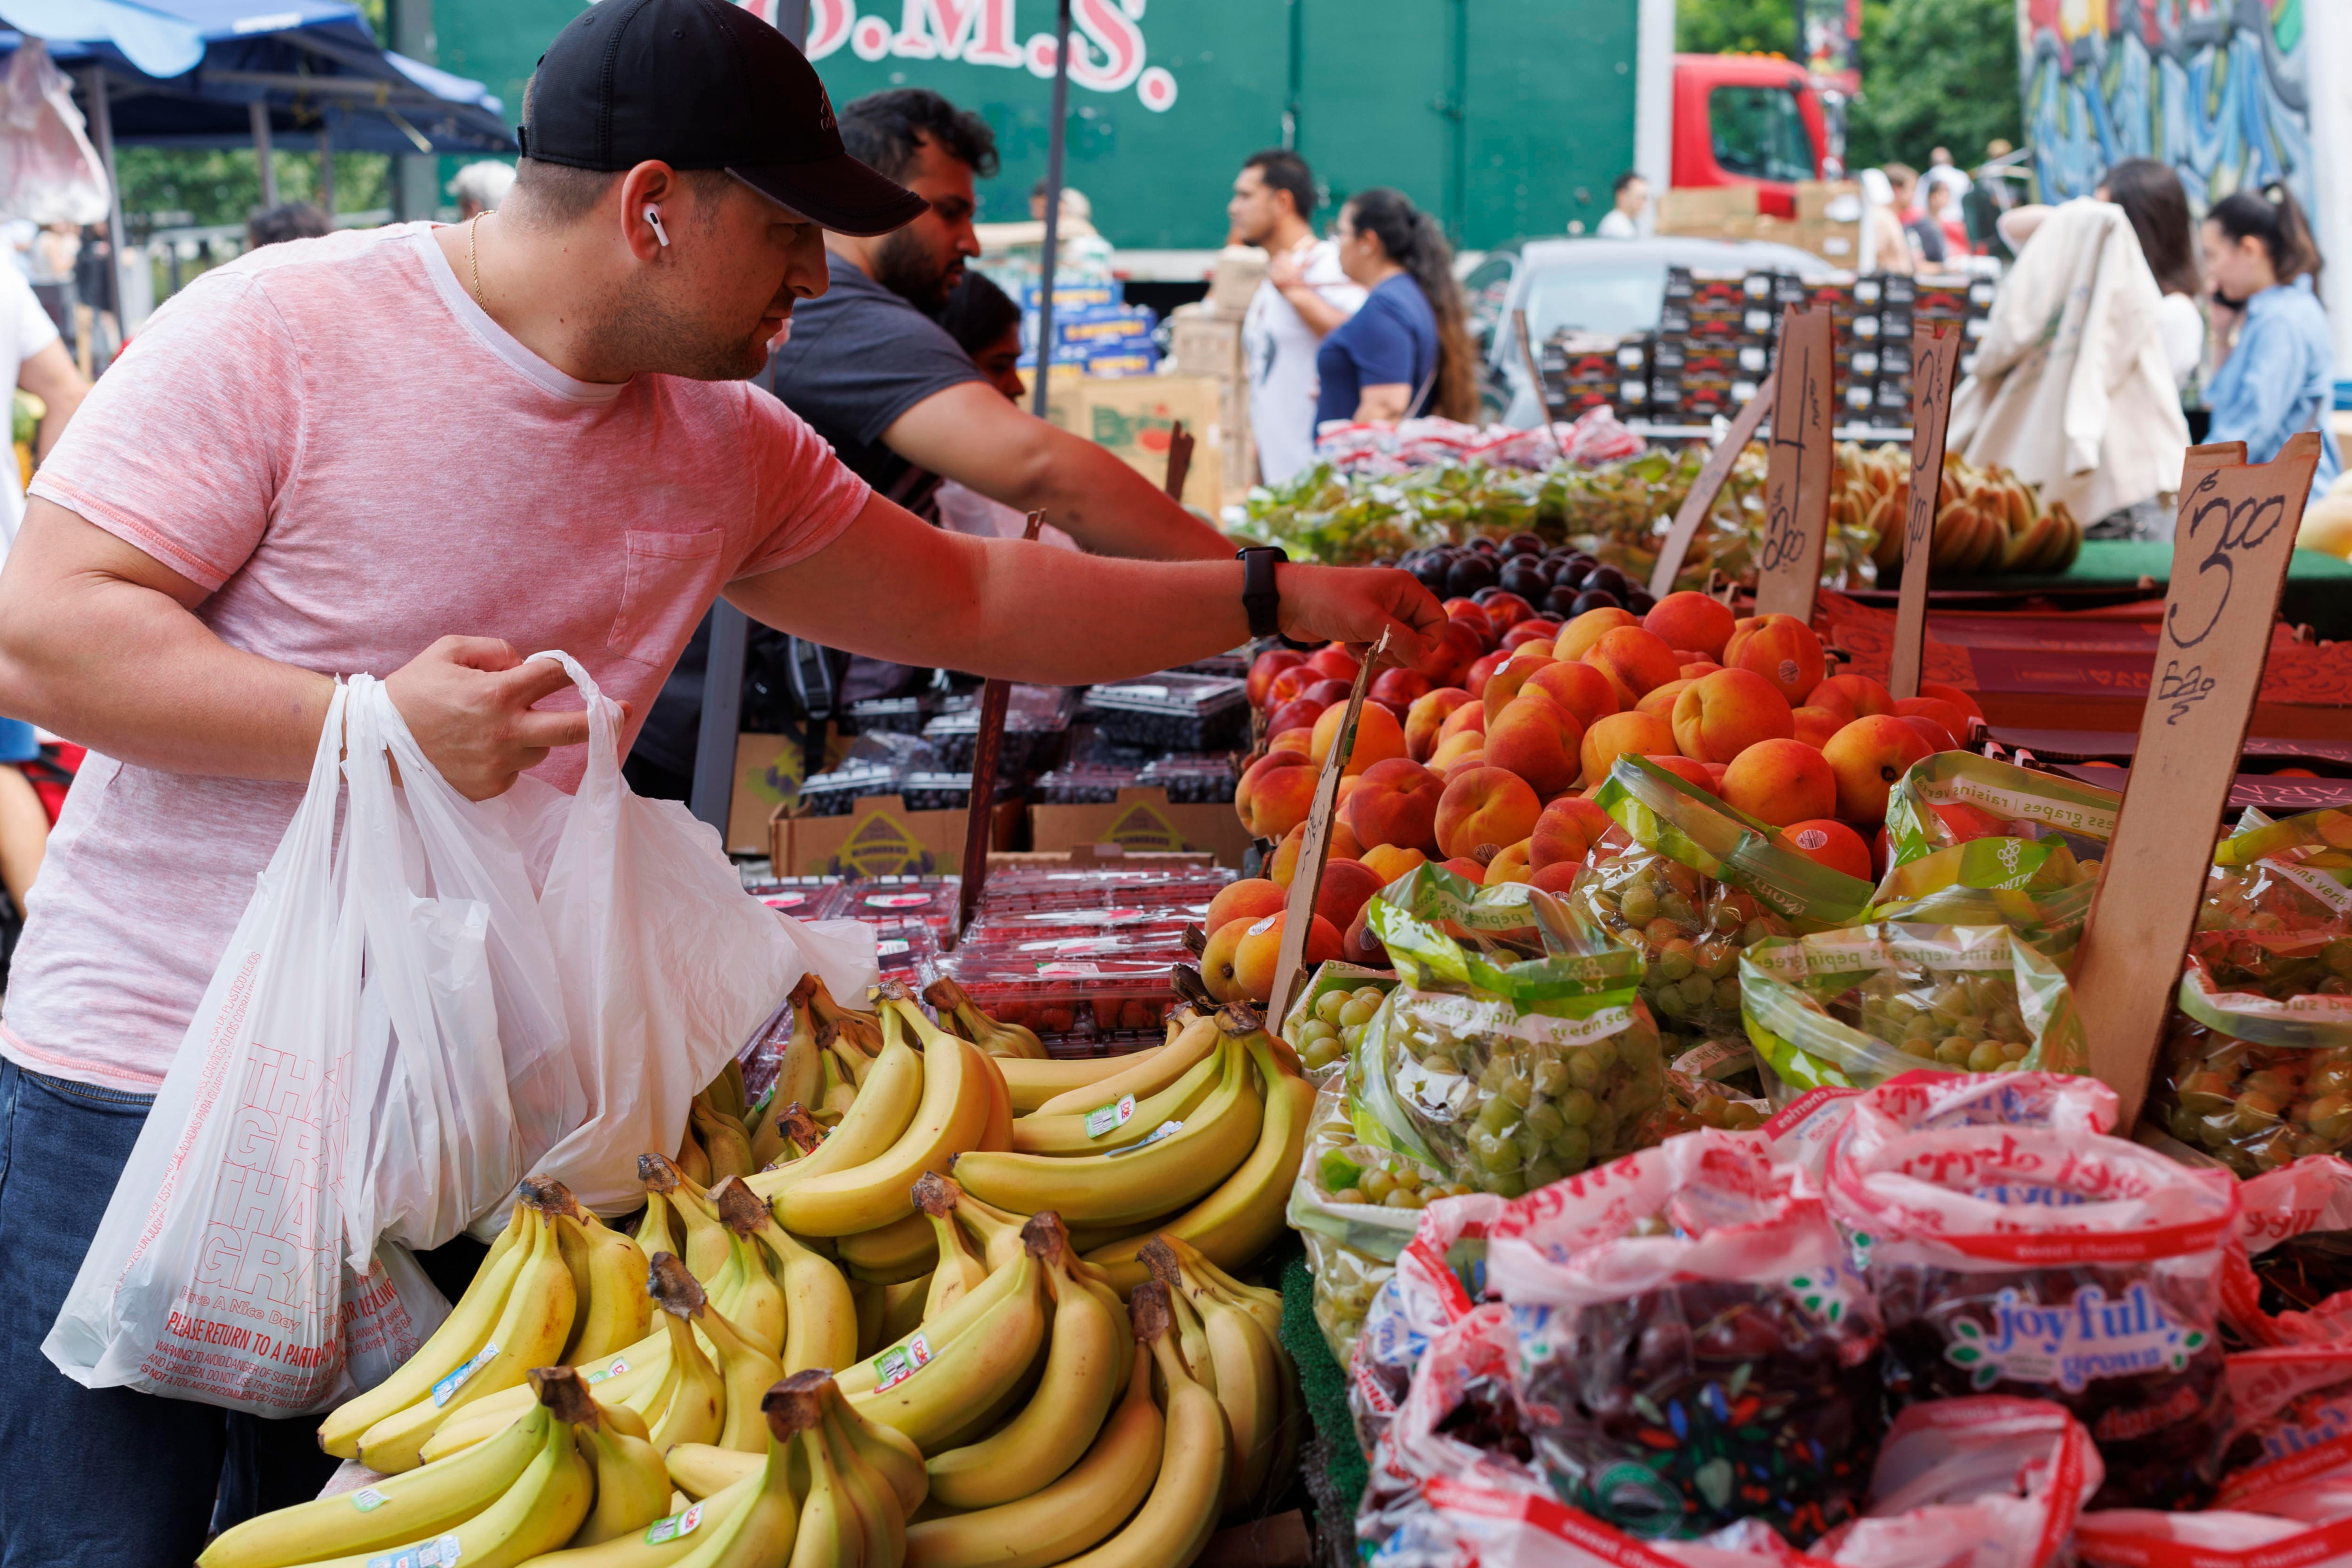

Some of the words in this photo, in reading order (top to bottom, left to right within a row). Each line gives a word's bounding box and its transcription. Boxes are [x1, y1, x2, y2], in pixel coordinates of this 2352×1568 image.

[2315, 879, 2348, 906] verts
[215, 1012, 228, 1026] DE
[240, 950, 261, 978] LEJOS
[219, 1036, 231, 1047] O
[222, 1020, 240, 1039] LOS
[201, 1044, 227, 1080] CARROS
[194, 1098, 214, 1122] PARA
[1121, 1100, 1132, 1119] Dole
[179, 1286, 211, 1307] Have
[213, 1295, 226, 1310] A
[229, 1298, 265, 1320] Nice
[269, 1310, 301, 1334] Day
[165, 1311, 206, 1341] PLEASE
[204, 1321, 252, 1350] RETURN
[252, 1333, 271, 1356] TO
[270, 1340, 282, 1361] A
[193, 1351, 204, 1363] TO
[203, 1353, 226, 1367] AVOID
[225, 1356, 259, 1376] DANGER
[259, 1367, 273, 1378] OF
[356, 1324, 377, 1341] AWAY
[913, 1339, 929, 1364] Dole
[146, 1353, 166, 1368] AND
[165, 1361, 204, 1379] CHILDREN.
[207, 1369, 220, 1381] DO
[219, 1371, 236, 1384] NOT
[236, 1375, 254, 1388] USE
[254, 1379, 273, 1393] THIS
[271, 1385, 290, 1398] BAG
[2062, 1348, 2161, 1385] grown
[140, 1363, 151, 1373] IS
[148, 1368, 168, 1382] NOT
[165, 1375, 174, 1385] A
[189, 1381, 211, 1391] NOT
[207, 1385, 270, 1401] RECOMMENDED
[268, 1397, 287, 1408] FOR
[686, 1507, 699, 1529] Dole
